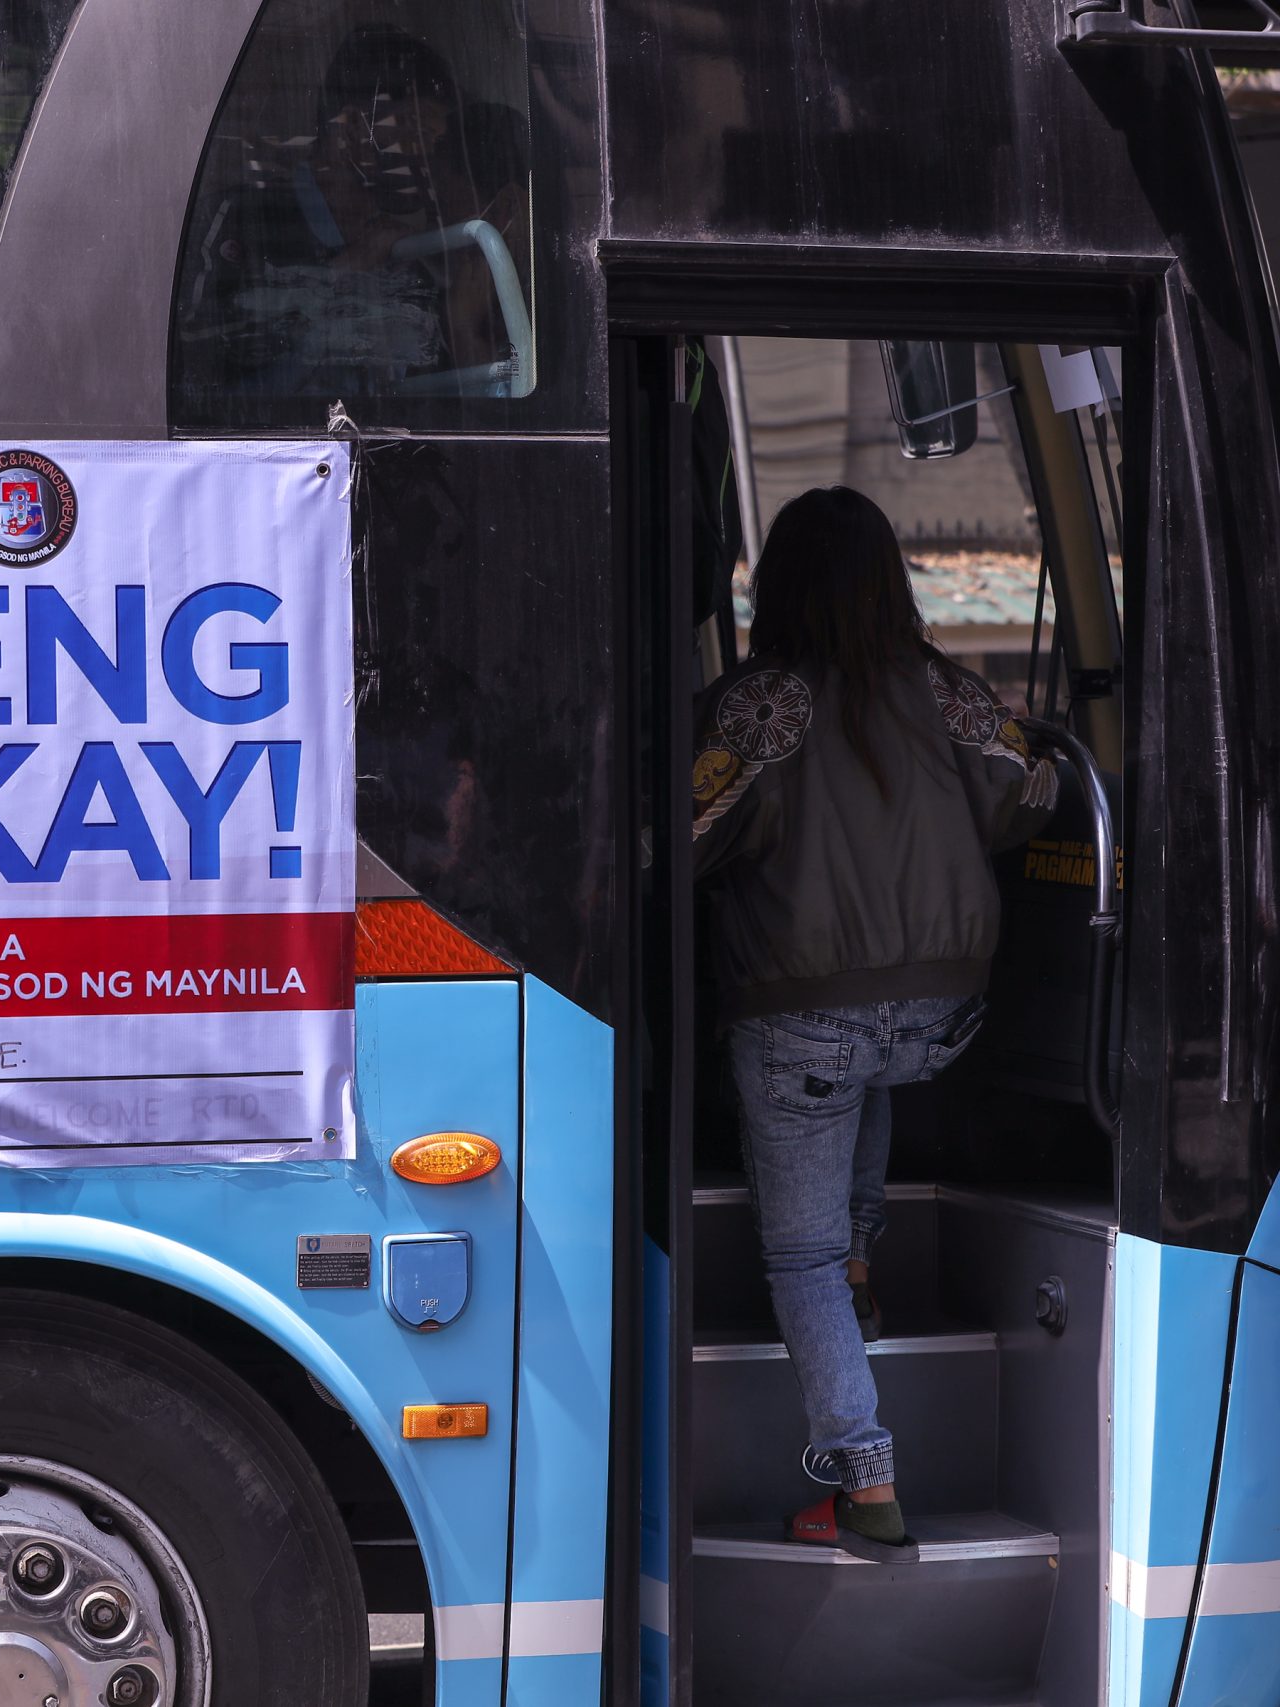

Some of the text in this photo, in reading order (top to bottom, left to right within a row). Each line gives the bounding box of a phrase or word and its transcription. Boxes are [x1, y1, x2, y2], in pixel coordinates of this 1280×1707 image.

[9, 453, 18, 465] &
[19, 453, 64, 485] PARKING
[57, 482, 74, 533] BUREAU
[17, 553, 28, 563] NG
[28, 542, 57, 561] MAYNILA
[81, 970, 133, 999] NG
[142, 966, 307, 997] MAYNILA
[420, 1298, 439, 1307] PUSH
